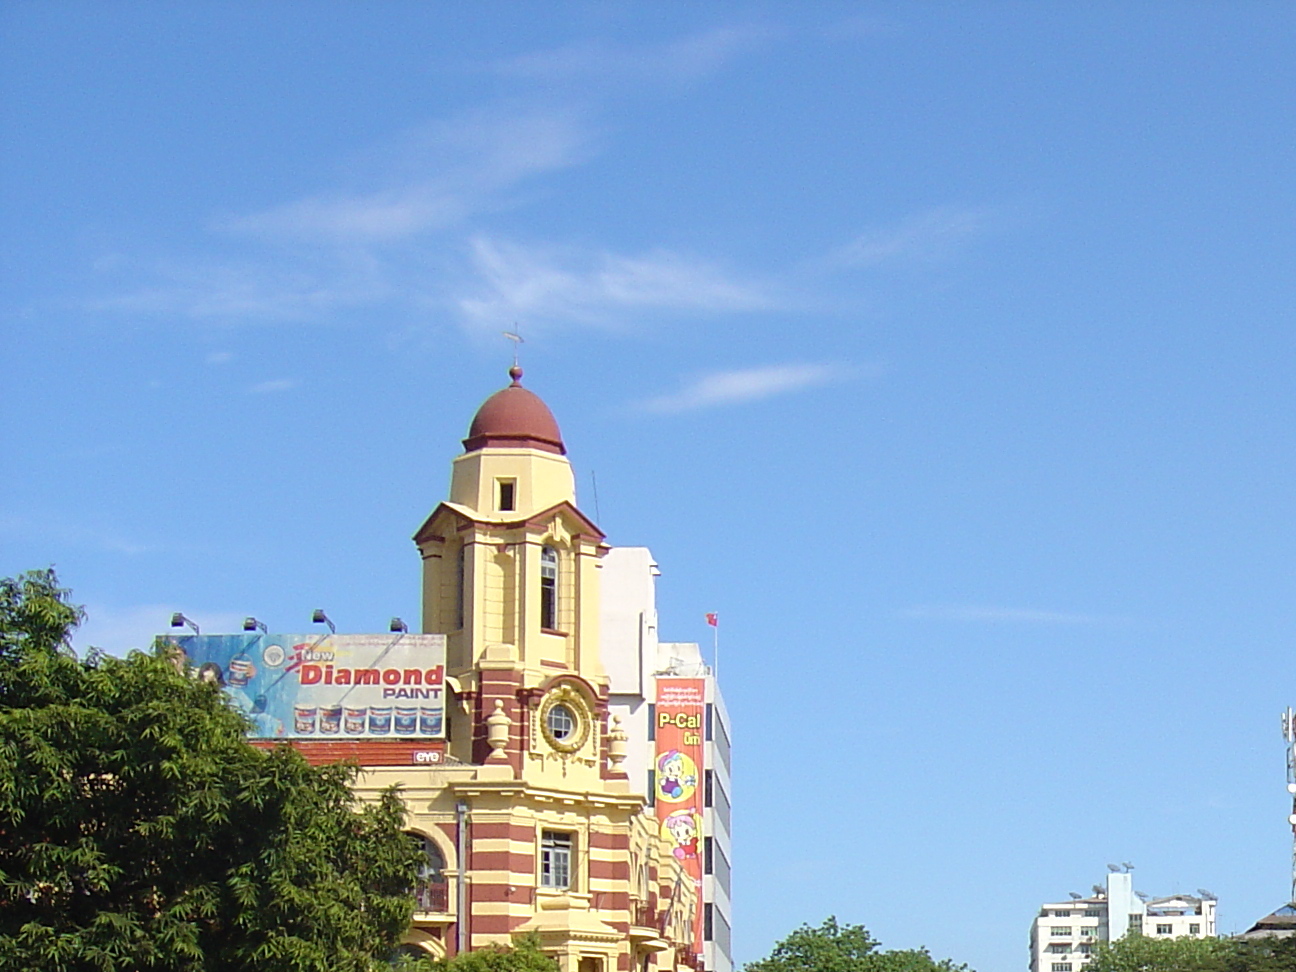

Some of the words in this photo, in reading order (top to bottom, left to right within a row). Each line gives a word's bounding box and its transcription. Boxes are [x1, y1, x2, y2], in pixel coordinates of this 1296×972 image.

[300, 649, 335, 662] New
[301, 664, 444, 686] Diamond
[383, 688, 443, 699] PAINT
[659, 712, 701, 729] P-Cal
